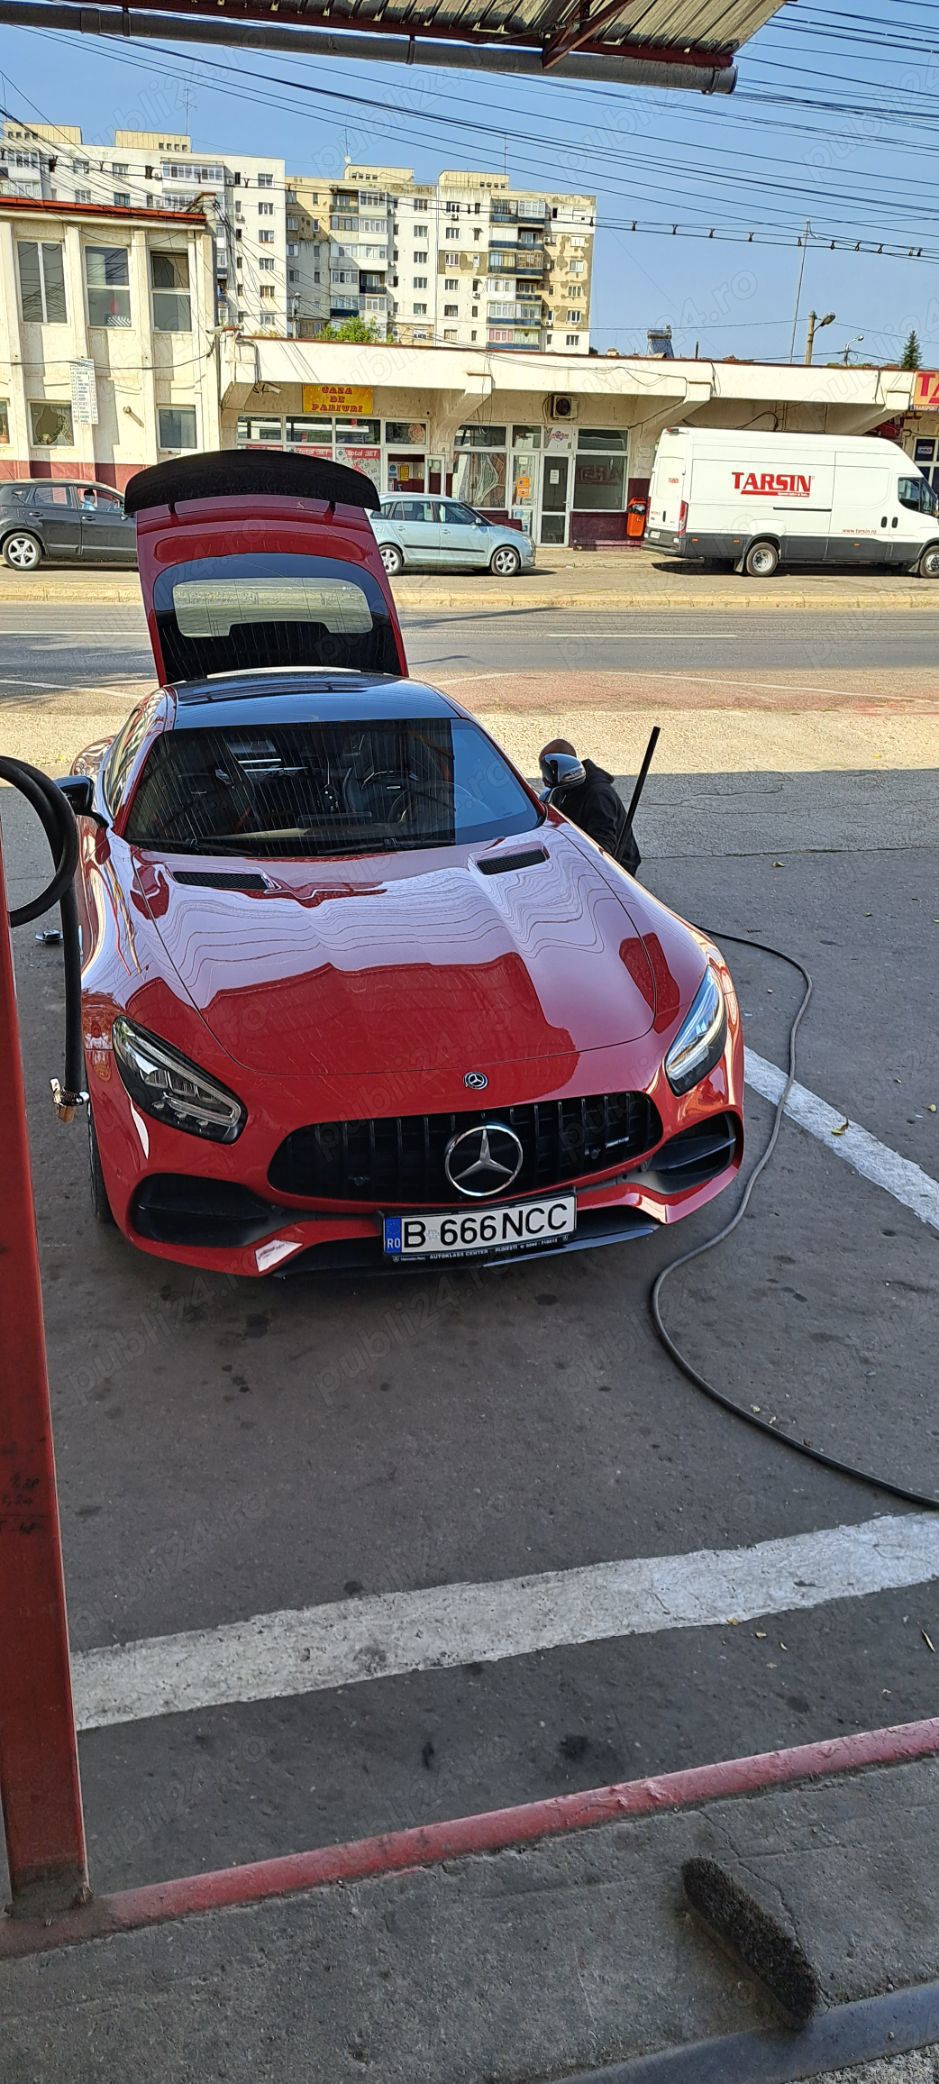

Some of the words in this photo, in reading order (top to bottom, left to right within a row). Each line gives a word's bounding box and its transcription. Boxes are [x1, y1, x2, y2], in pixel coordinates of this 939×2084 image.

[329, 395, 345, 403] DE
[311, 403, 363, 412] PARIURI
[731, 472, 812, 492] TARSIN
[403, 1221, 427, 1248] B
[387, 1237, 400, 1249] RO
[465, 1249, 488, 1257] CENTER
